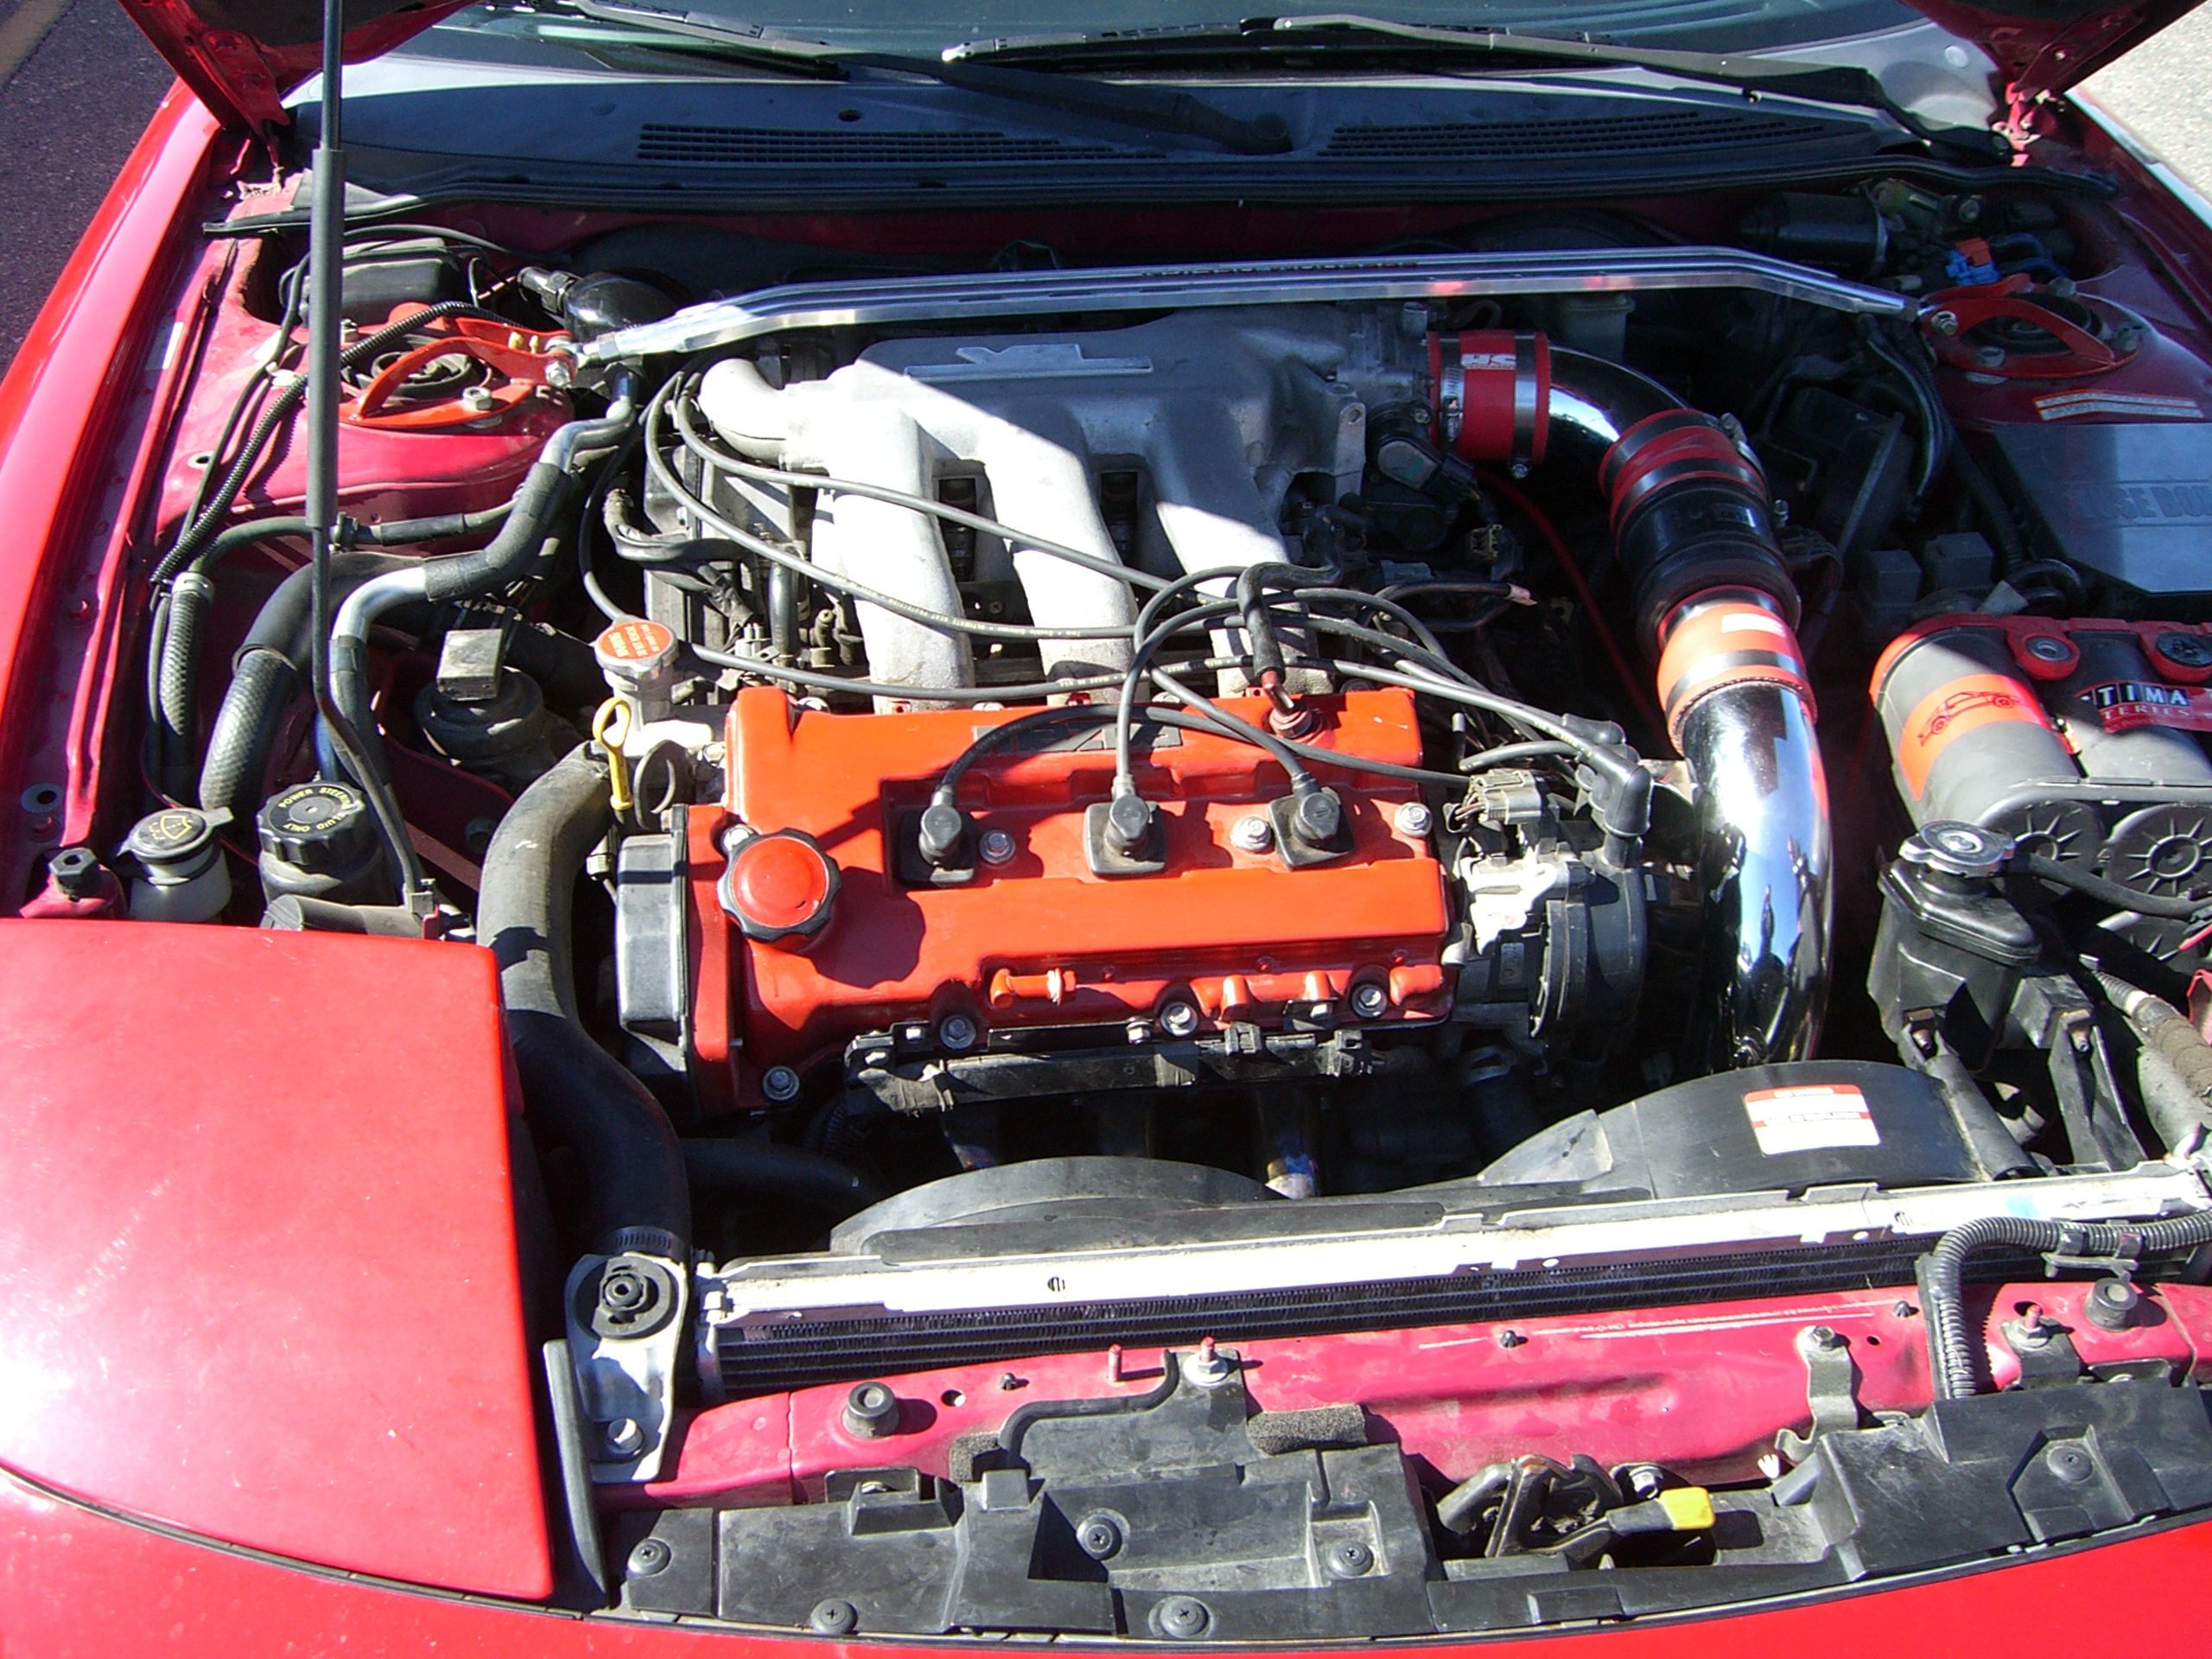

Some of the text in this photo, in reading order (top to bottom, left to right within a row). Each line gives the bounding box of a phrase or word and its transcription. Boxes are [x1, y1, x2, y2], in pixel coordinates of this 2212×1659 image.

[931, 613, 949, 623] HEAT
[2082, 684, 2188, 707] TIMA
[2103, 704, 2190, 720] TERIES
[278, 788, 314, 808] POWER
[283, 822, 311, 833] ONLY
